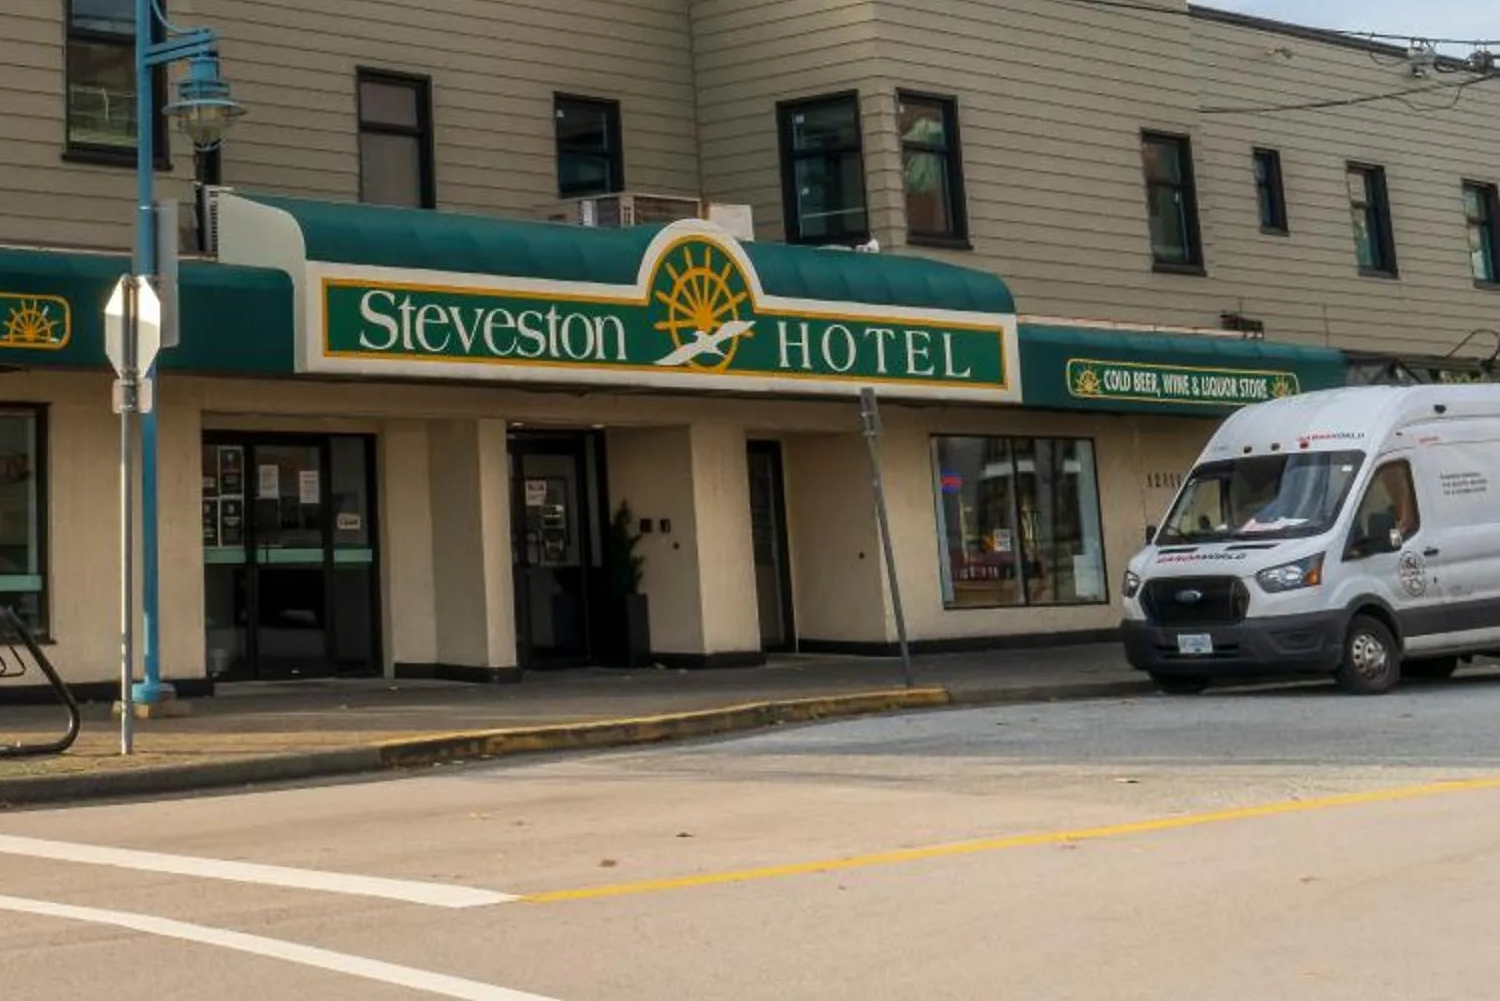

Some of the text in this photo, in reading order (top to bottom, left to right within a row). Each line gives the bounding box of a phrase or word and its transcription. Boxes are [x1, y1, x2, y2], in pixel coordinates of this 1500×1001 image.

[359, 289, 972, 378] Steveston HOTEL
[1103, 370, 1269, 399] COLD BEER, WINE & LIQUOR STORE
